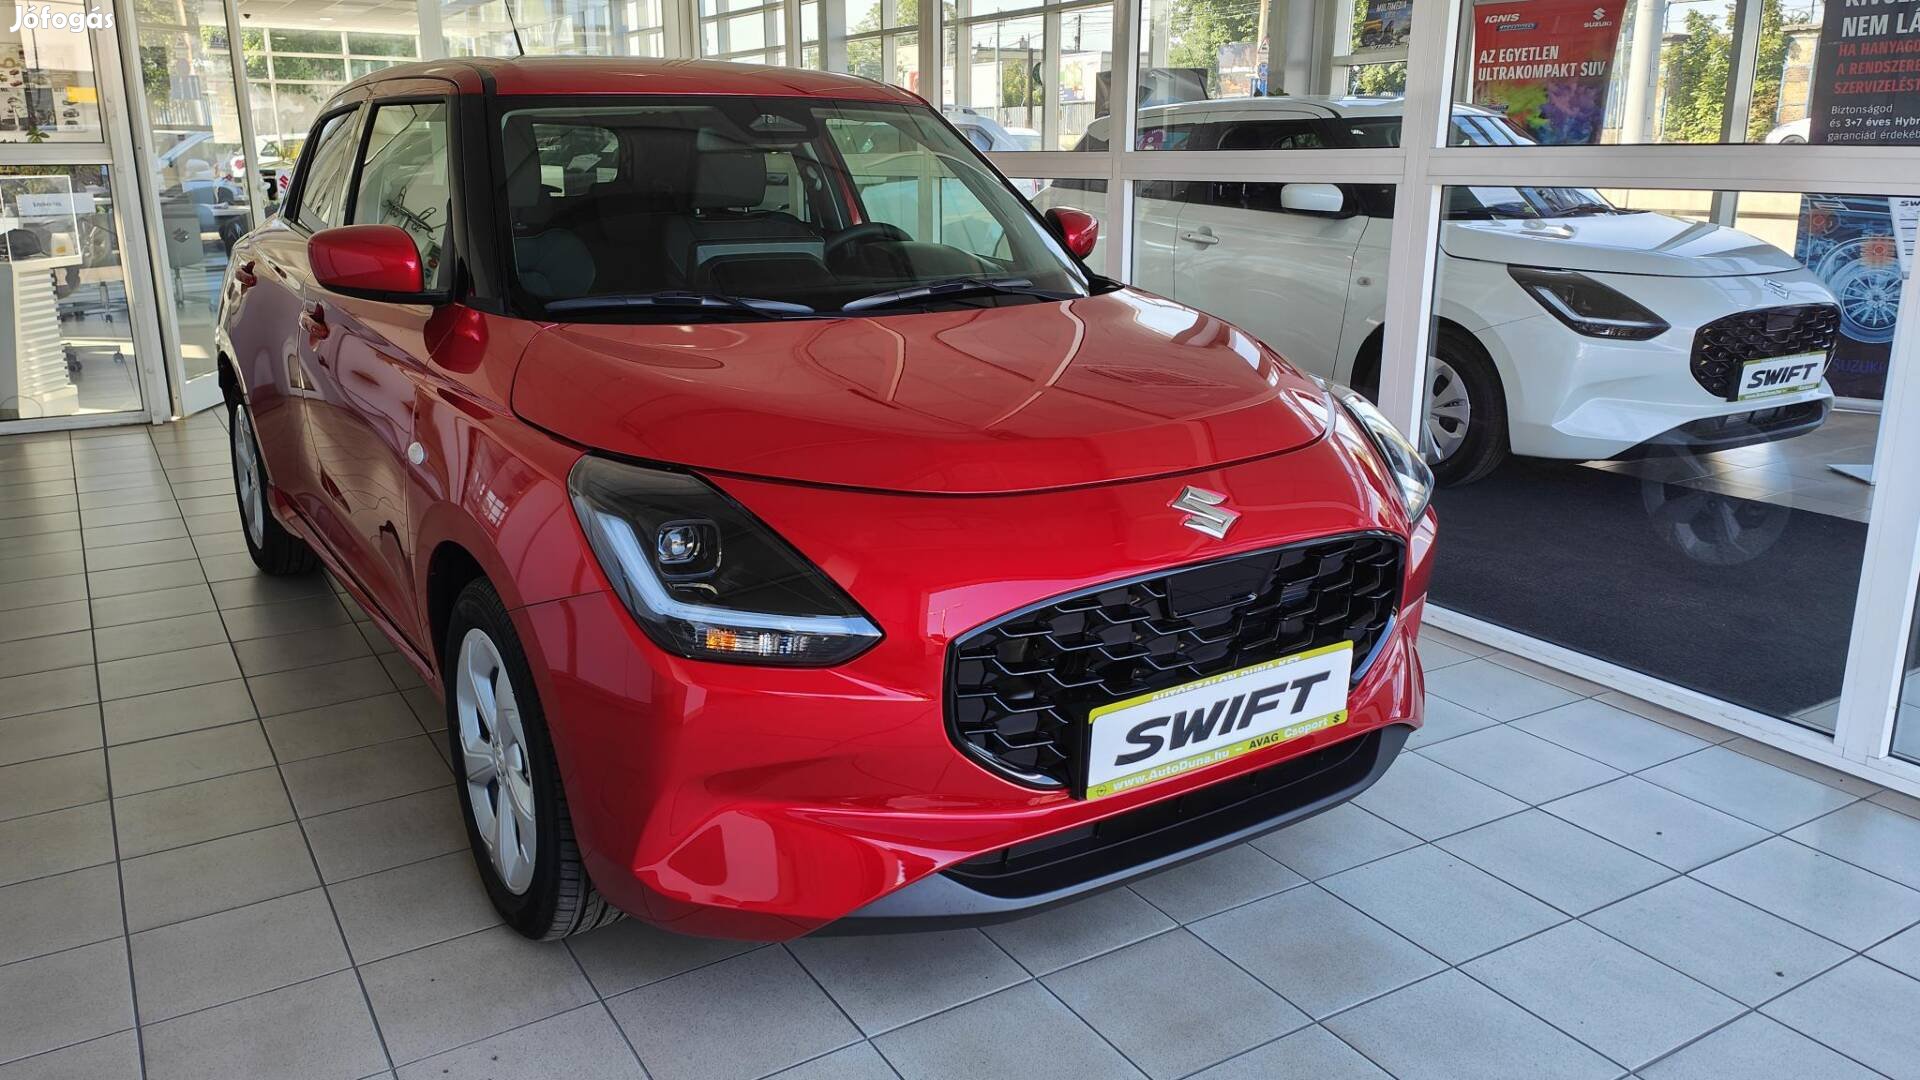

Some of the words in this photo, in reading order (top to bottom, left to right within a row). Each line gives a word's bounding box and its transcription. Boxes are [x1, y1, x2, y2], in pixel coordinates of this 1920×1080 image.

[1484, 13, 1520, 24] IGNIS
[1842, 14, 1888, 37] NEM
[1479, 50, 1495, 64] AZ
[1498, 45, 1559, 63] EGYETLEN
[1838, 43, 1856, 57] HA
[1478, 62, 1577, 81] ULTRAKOMPAKT
[1580, 61, 1606, 77] SUV
[1836, 63, 1845, 76] A
[1831, 104, 1893, 115] Biztonságod
[1829, 119, 1841, 127] és
[1845, 118, 1862, 127] 3+7
[1866, 117, 1891, 127] éves
[1747, 363, 1818, 388] SWIFT
[1114, 670, 1331, 766] SWIFT
[1113, 749, 1230, 791] www.AutoDuna.hu
[1249, 733, 1279, 750] AVAG
[1284, 717, 1328, 738] Csoport
